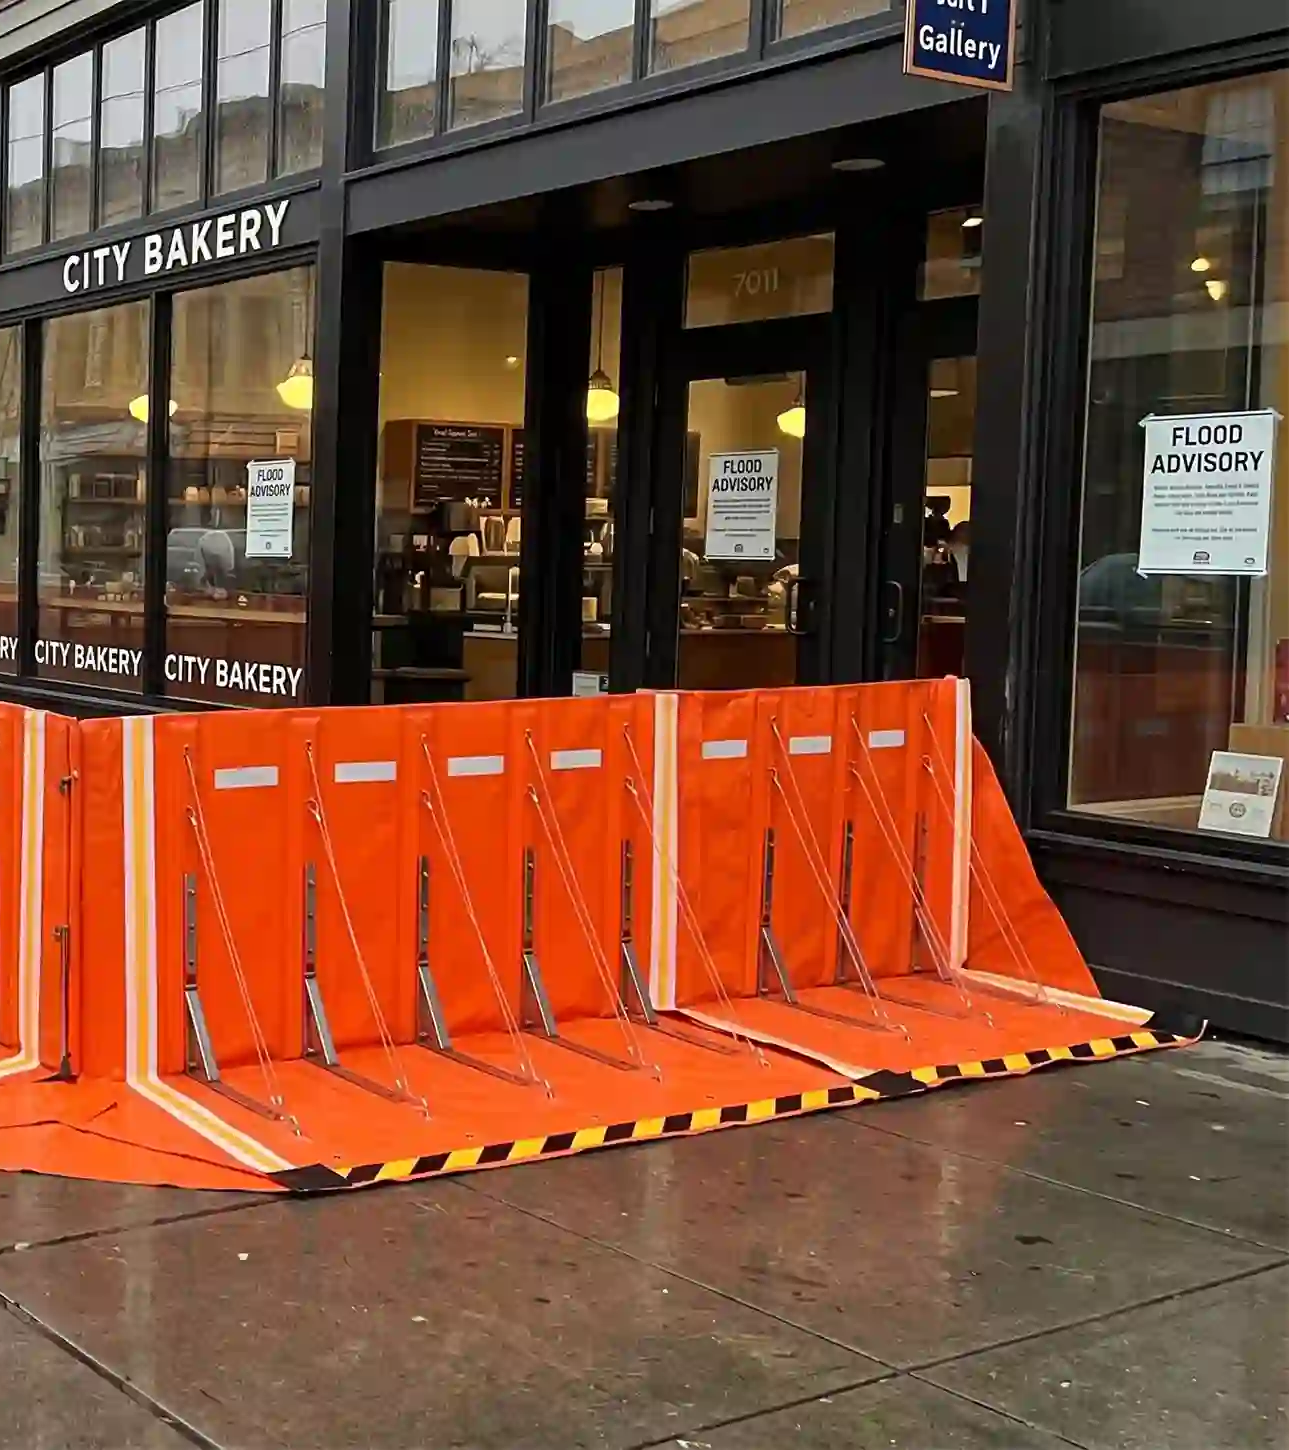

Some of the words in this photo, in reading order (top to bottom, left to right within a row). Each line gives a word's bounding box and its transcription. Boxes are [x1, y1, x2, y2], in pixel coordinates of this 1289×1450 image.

[919, 24, 1001, 70] Gallery
[63, 241, 131, 293] CITY
[144, 199, 289, 275] BAKERY
[731, 267, 779, 298] 7011
[1172, 424, 1243, 447] FLOOD
[723, 459, 762, 474] FLOOD
[1151, 451, 1264, 474] ADVISORY
[257, 468, 284, 482] FLOOD
[712, 477, 773, 492] ADVISORY
[251, 484, 291, 497] ADVISORY
[34, 640, 72, 667] CITY
[74, 644, 143, 677] BAKERY
[164, 653, 211, 685] CITY
[216, 659, 303, 697] BAKERY
